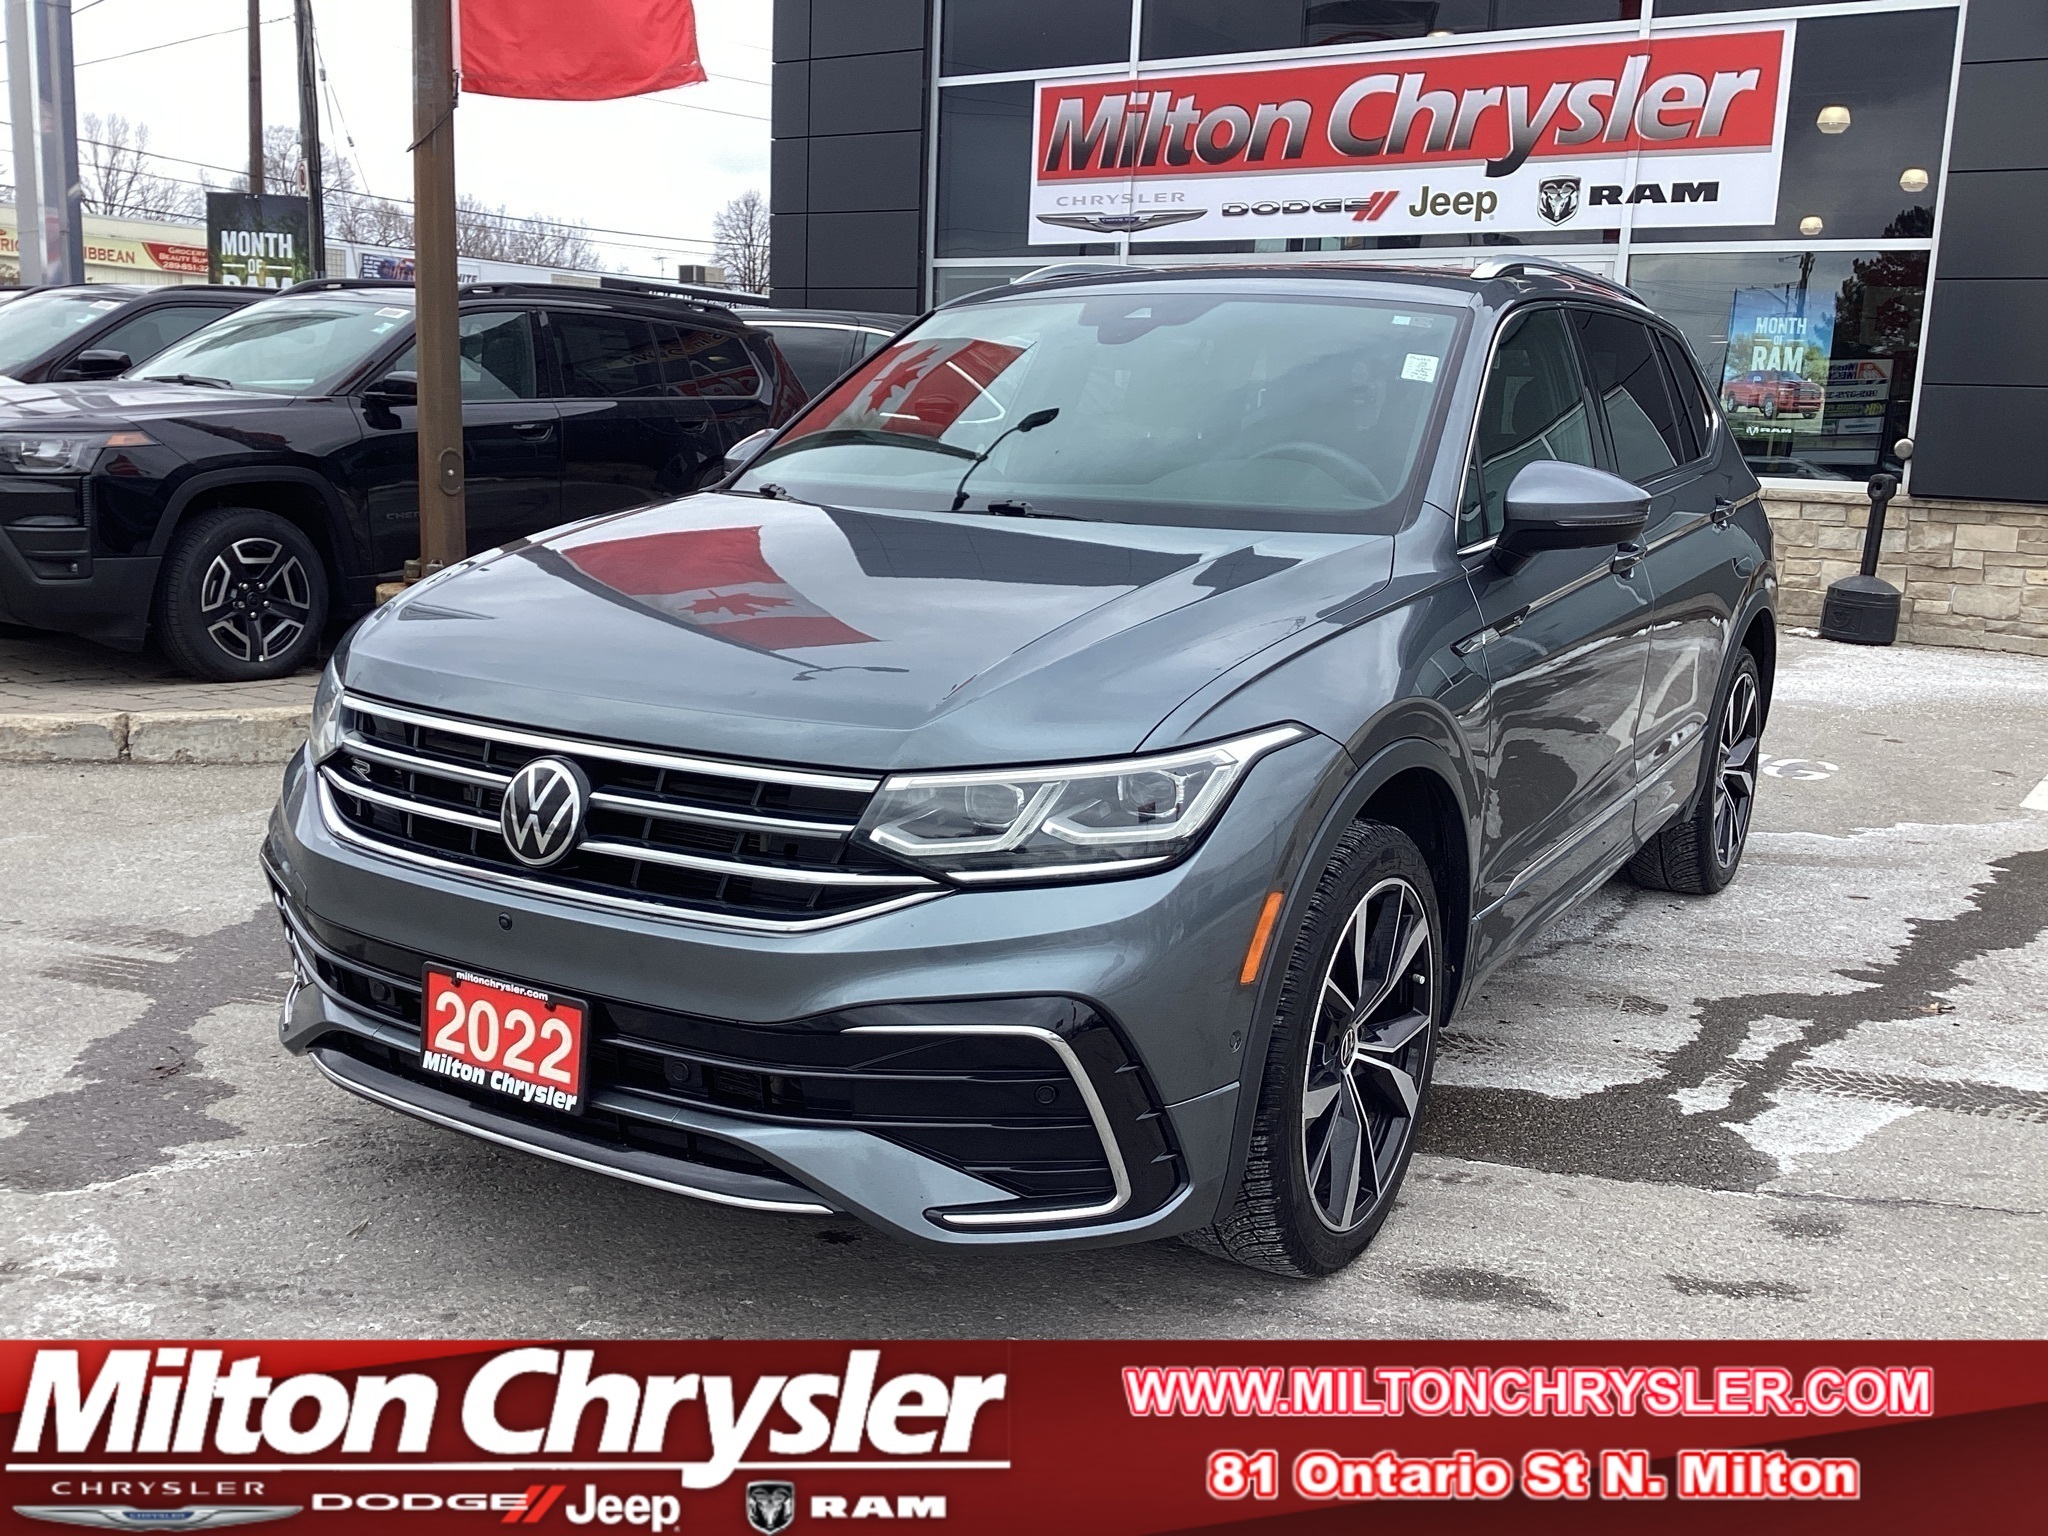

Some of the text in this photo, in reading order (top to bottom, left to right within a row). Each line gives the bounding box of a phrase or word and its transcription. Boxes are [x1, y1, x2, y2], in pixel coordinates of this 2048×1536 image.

[1044, 54, 1761, 178] Milton Chrysler
[1056, 192, 1185, 206] CHRYSLER
[1409, 185, 1498, 222] Jeep
[1589, 181, 1720, 205] RAM
[1222, 197, 1372, 216] DODGE
[83, 246, 136, 265] IBBEAN
[221, 230, 293, 259] MONTH
[162, 261, 209, 273] 289-851-32
[247, 258, 263, 274] OF
[1755, 317, 1808, 335] MONTH
[1773, 334, 1784, 345] OF
[1751, 346, 1804, 374] RAM
[456, 971, 549, 1001] miltonchrysler.com
[434, 991, 573, 1084] 2022
[422, 1050, 578, 1112] Milton Chrysler
